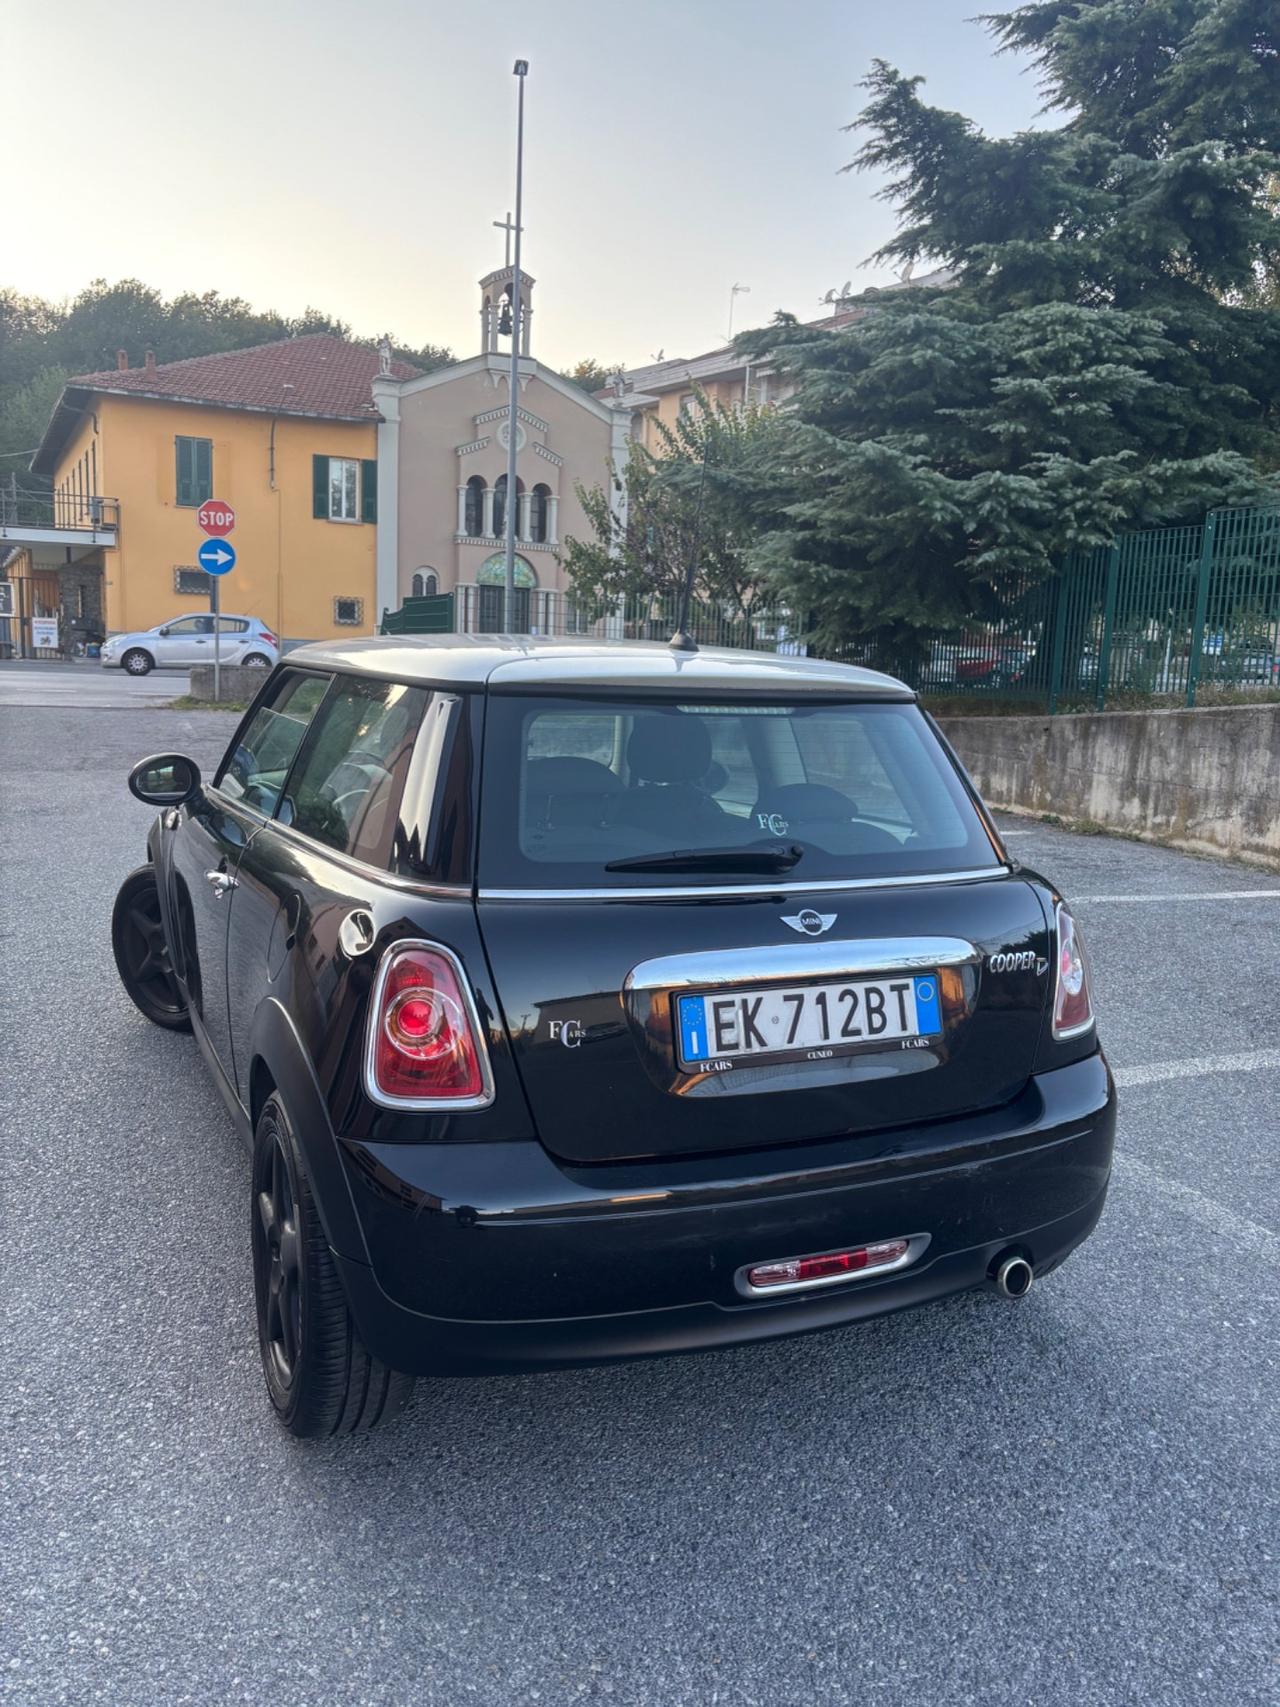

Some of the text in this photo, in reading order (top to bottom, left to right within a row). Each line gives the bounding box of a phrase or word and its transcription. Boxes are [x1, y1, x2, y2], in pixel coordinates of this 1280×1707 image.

[200, 511, 234, 526] STOP
[802, 917, 821, 926] MINI
[990, 950, 1049, 977] COOPER D
[713, 996, 768, 1052] EK
[783, 983, 910, 1045] 712BT
[700, 1038, 930, 1073] FCARS CUNEO FCARS
